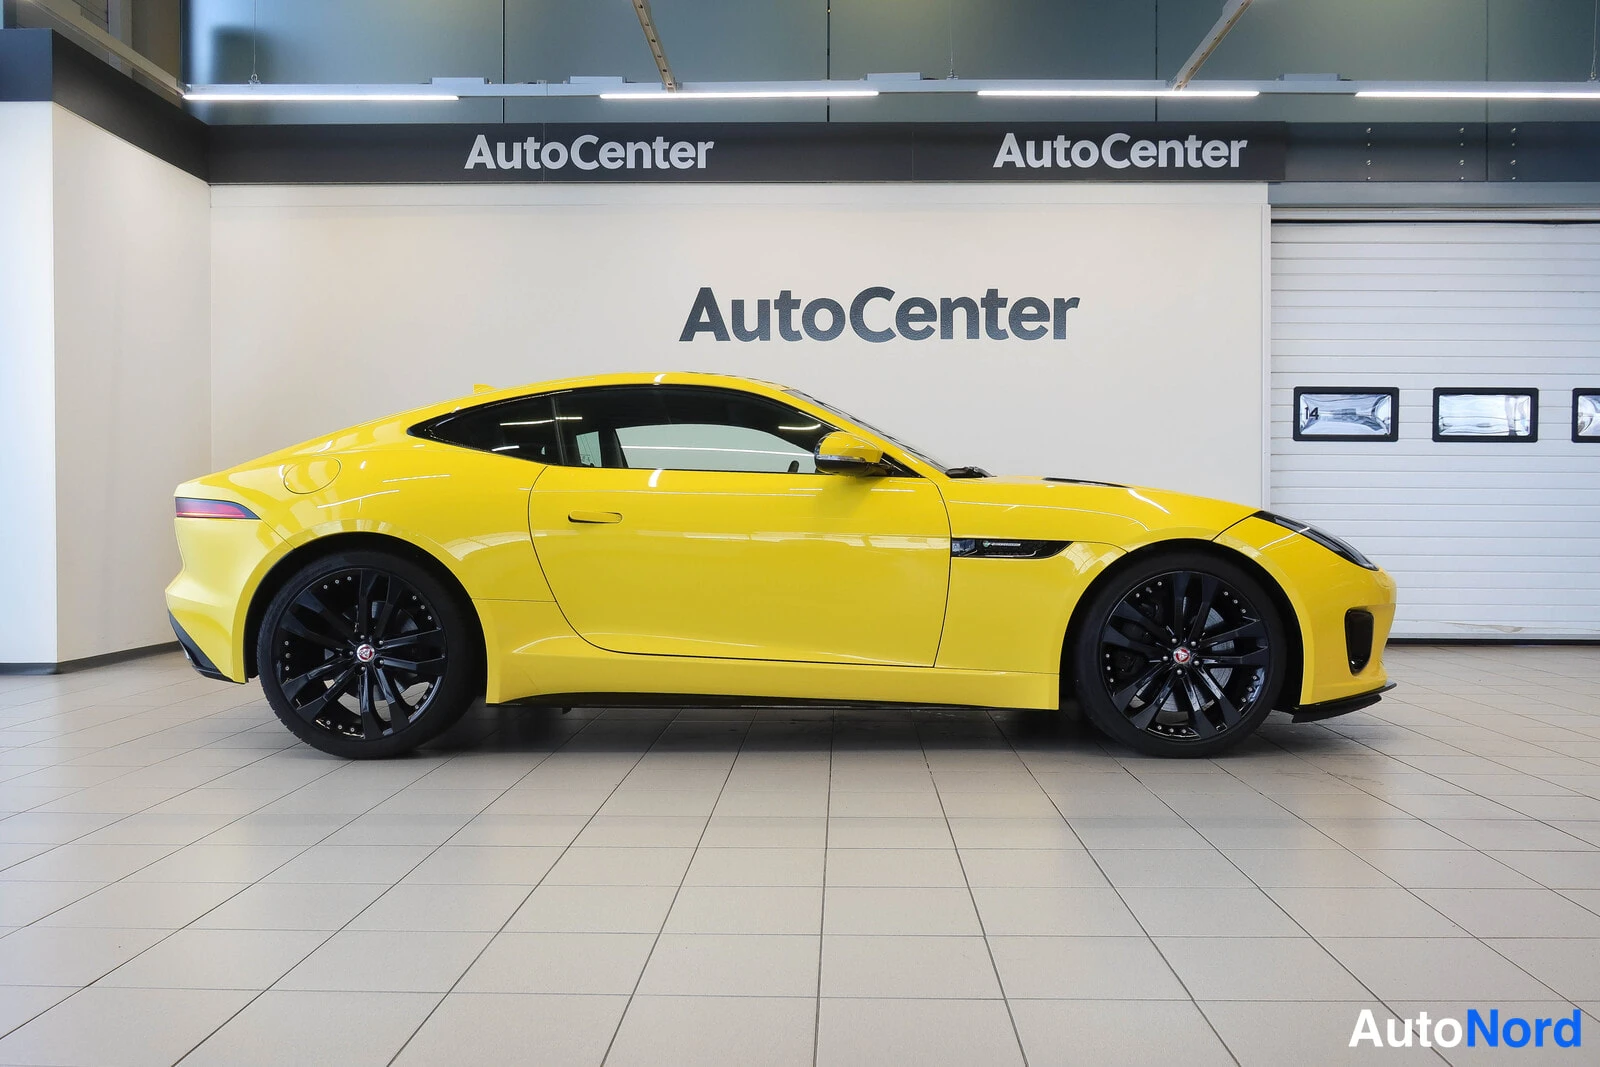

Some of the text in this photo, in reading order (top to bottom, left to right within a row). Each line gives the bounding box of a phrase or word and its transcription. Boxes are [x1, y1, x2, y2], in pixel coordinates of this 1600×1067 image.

[464, 134, 715, 171] AutoCenter
[993, 132, 1248, 169] AutoCenter
[678, 286, 1081, 343] AutoCenter
[1304, 406, 1319, 420] 14
